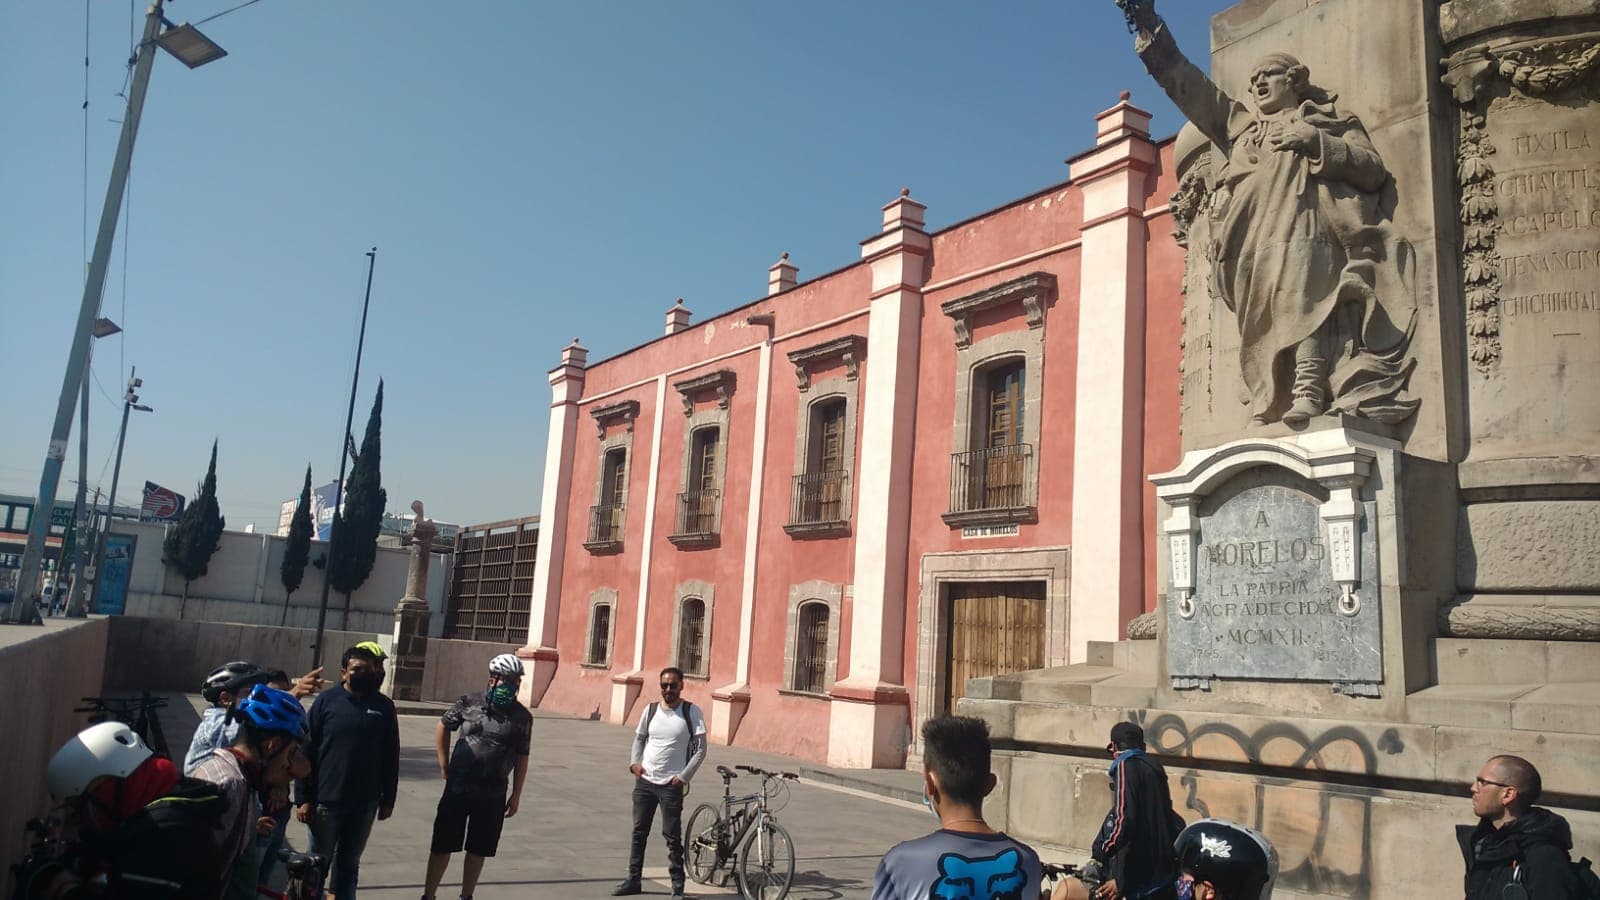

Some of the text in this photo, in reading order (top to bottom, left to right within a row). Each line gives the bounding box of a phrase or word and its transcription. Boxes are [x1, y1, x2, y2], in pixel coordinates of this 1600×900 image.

[1511, 130, 1591, 155] TIXTLA
[1500, 168, 1600, 197] CHIAUTL
[1254, 510, 1270, 529] A
[963, 527, 978, 537] CASA
[990, 525, 1018, 536] MORELOS
[1204, 537, 1326, 569] MORELOS
[1220, 580, 1308, 597] LA PATRIA
